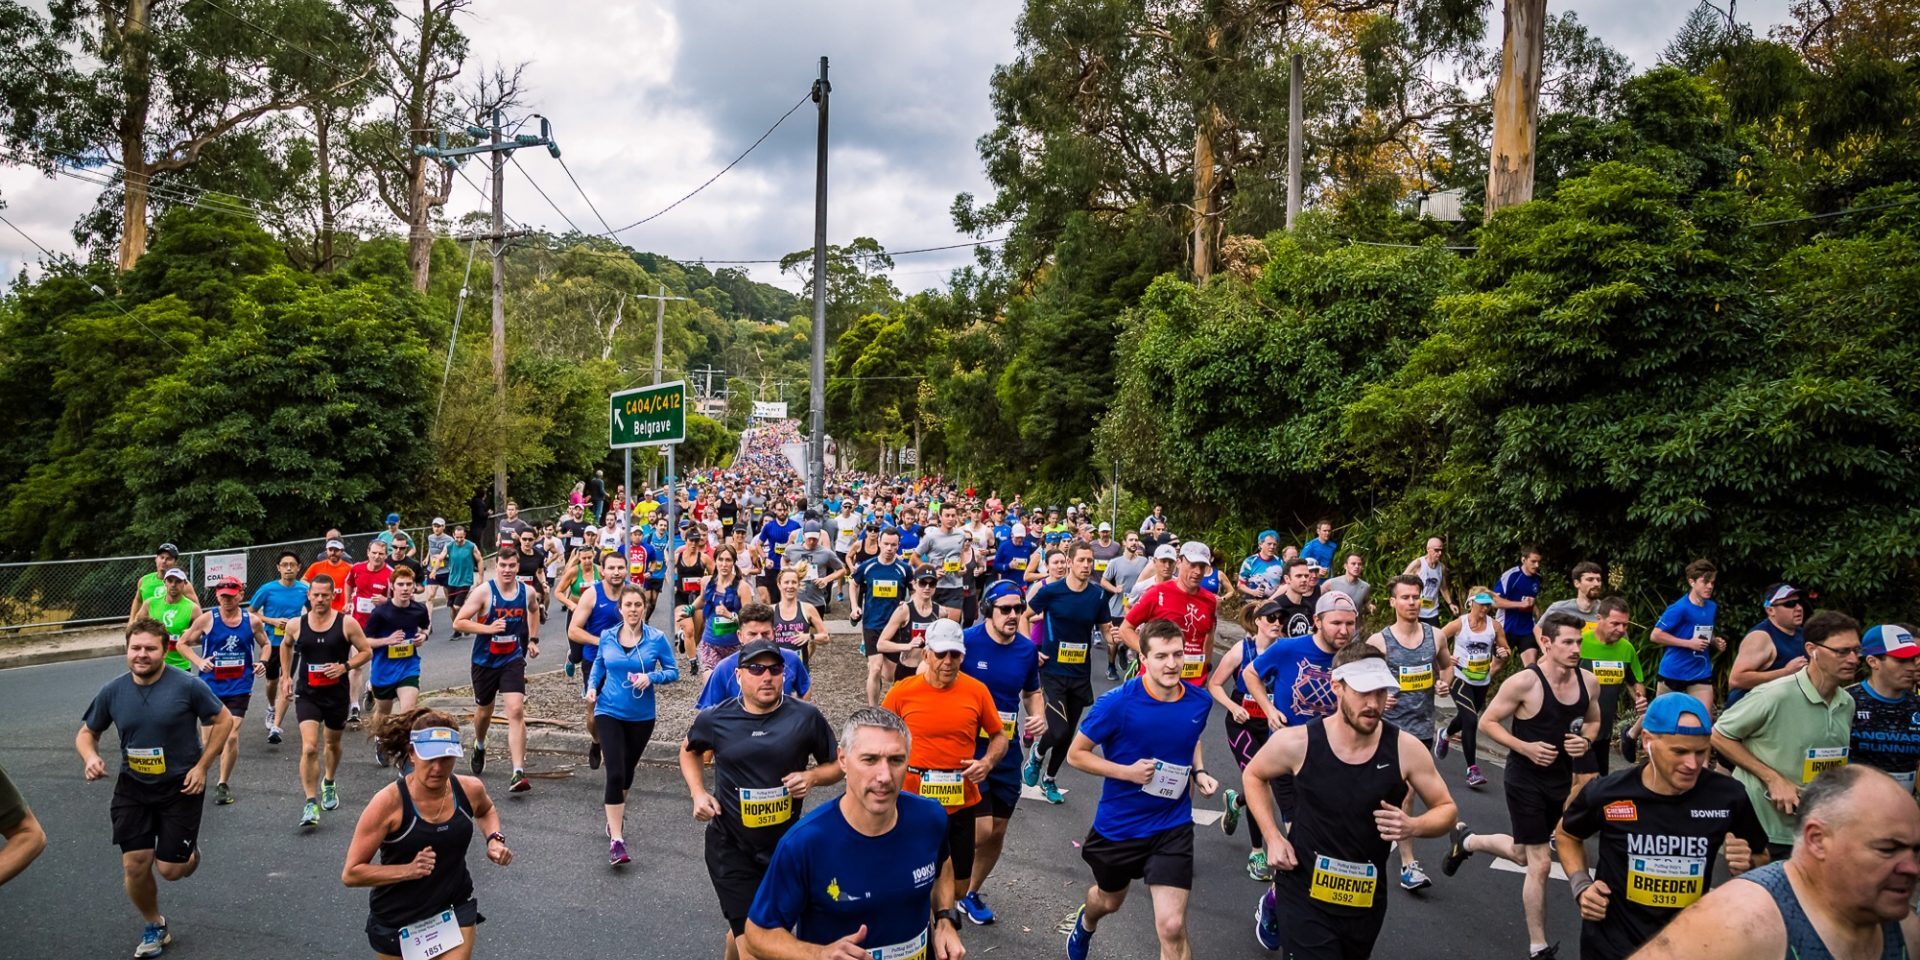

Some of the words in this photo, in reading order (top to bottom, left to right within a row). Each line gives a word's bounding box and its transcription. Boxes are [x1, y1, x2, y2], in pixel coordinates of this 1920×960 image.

[625, 393, 680, 416] C404/C412
[633, 419, 671, 438] Belgrave
[921, 784, 962, 795] GUTTMANN
[744, 799, 790, 816] HOPKINS
[758, 815, 777, 825] 3578
[1627, 833, 1708, 857] MAGPIES
[1315, 872, 1374, 893] LAURENCE
[1633, 875, 1697, 894] BREEDEN
[1332, 892, 1353, 903] 3592
[1652, 894, 1677, 904] 3319
[424, 943, 443, 957] 1851
